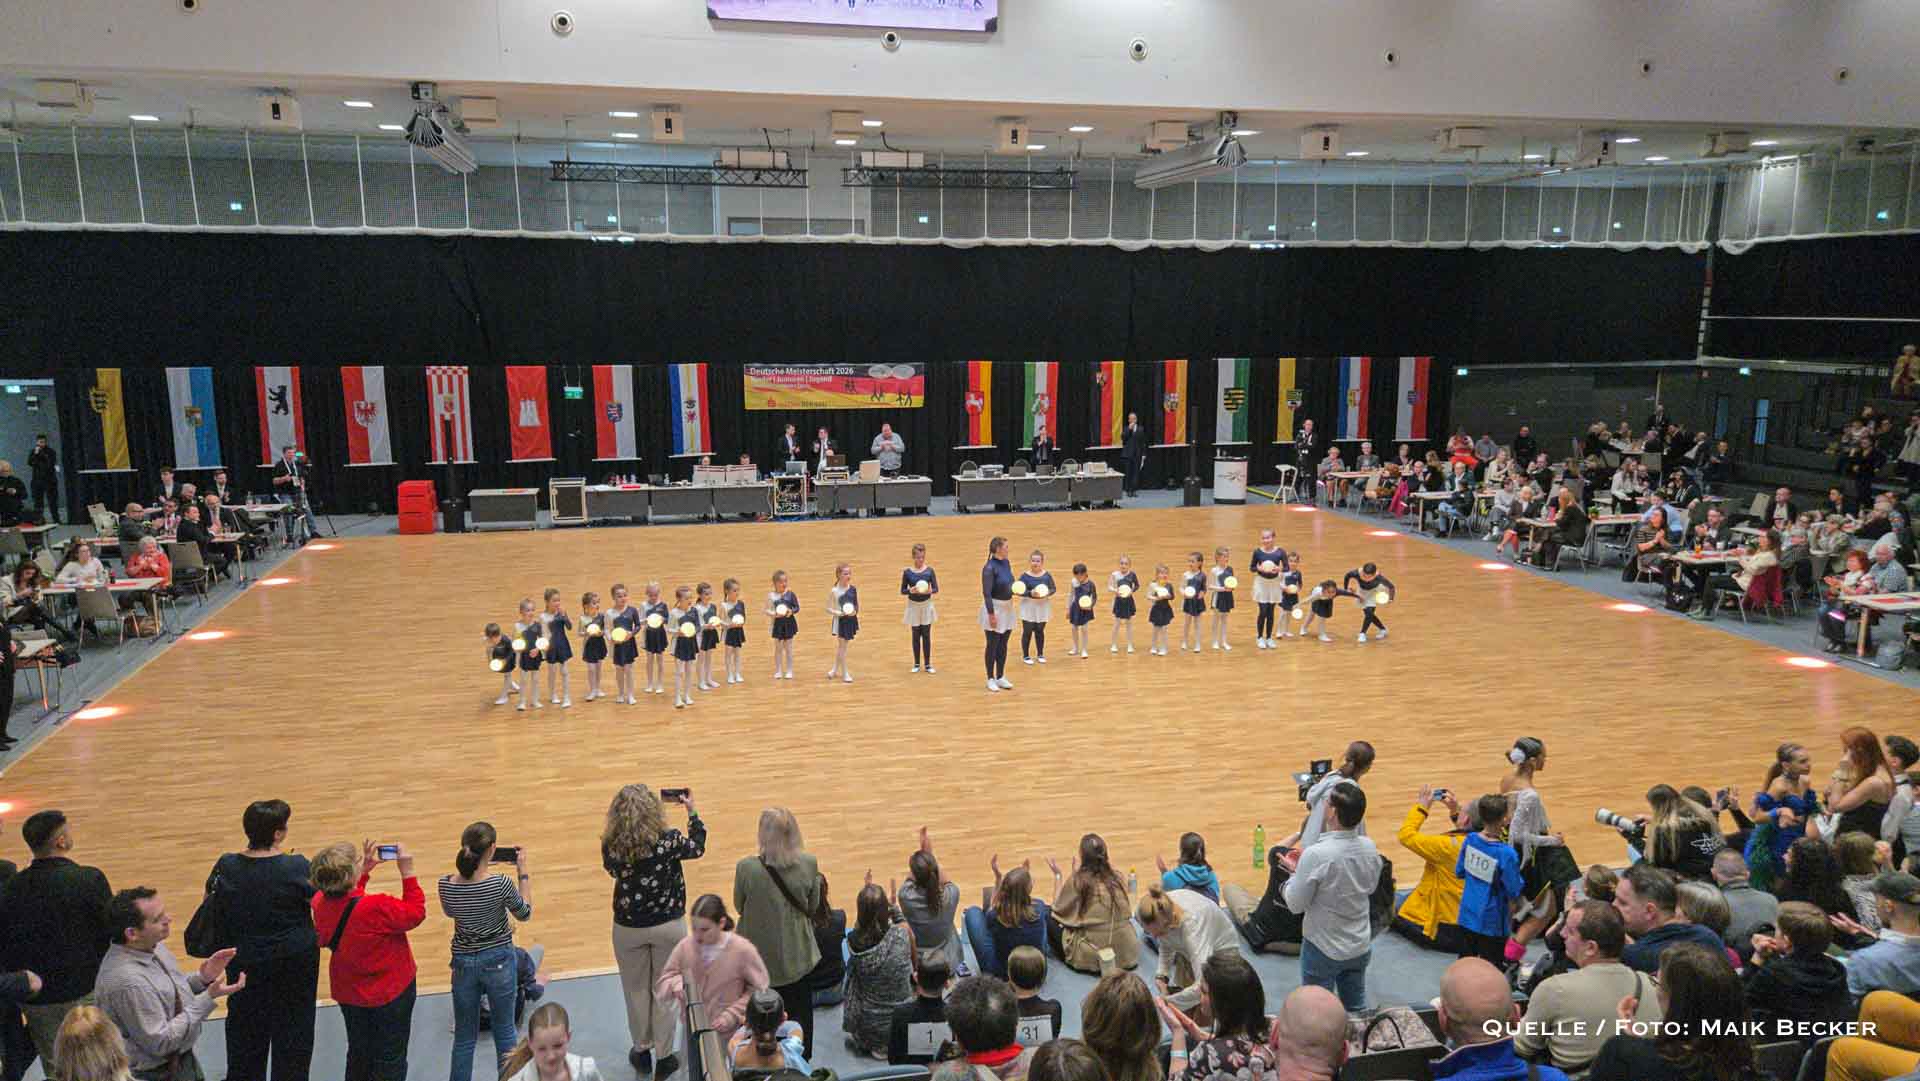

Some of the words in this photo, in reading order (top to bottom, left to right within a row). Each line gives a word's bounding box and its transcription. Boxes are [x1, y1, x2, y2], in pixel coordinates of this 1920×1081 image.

[750, 367, 784, 375] Deutsche
[785, 367, 835, 375] Meisterschaft
[836, 367, 854, 375] 2026
[1470, 853, 1489, 871] 110
[927, 1030, 933, 1043] 1
[1022, 1026, 1039, 1040] 31
